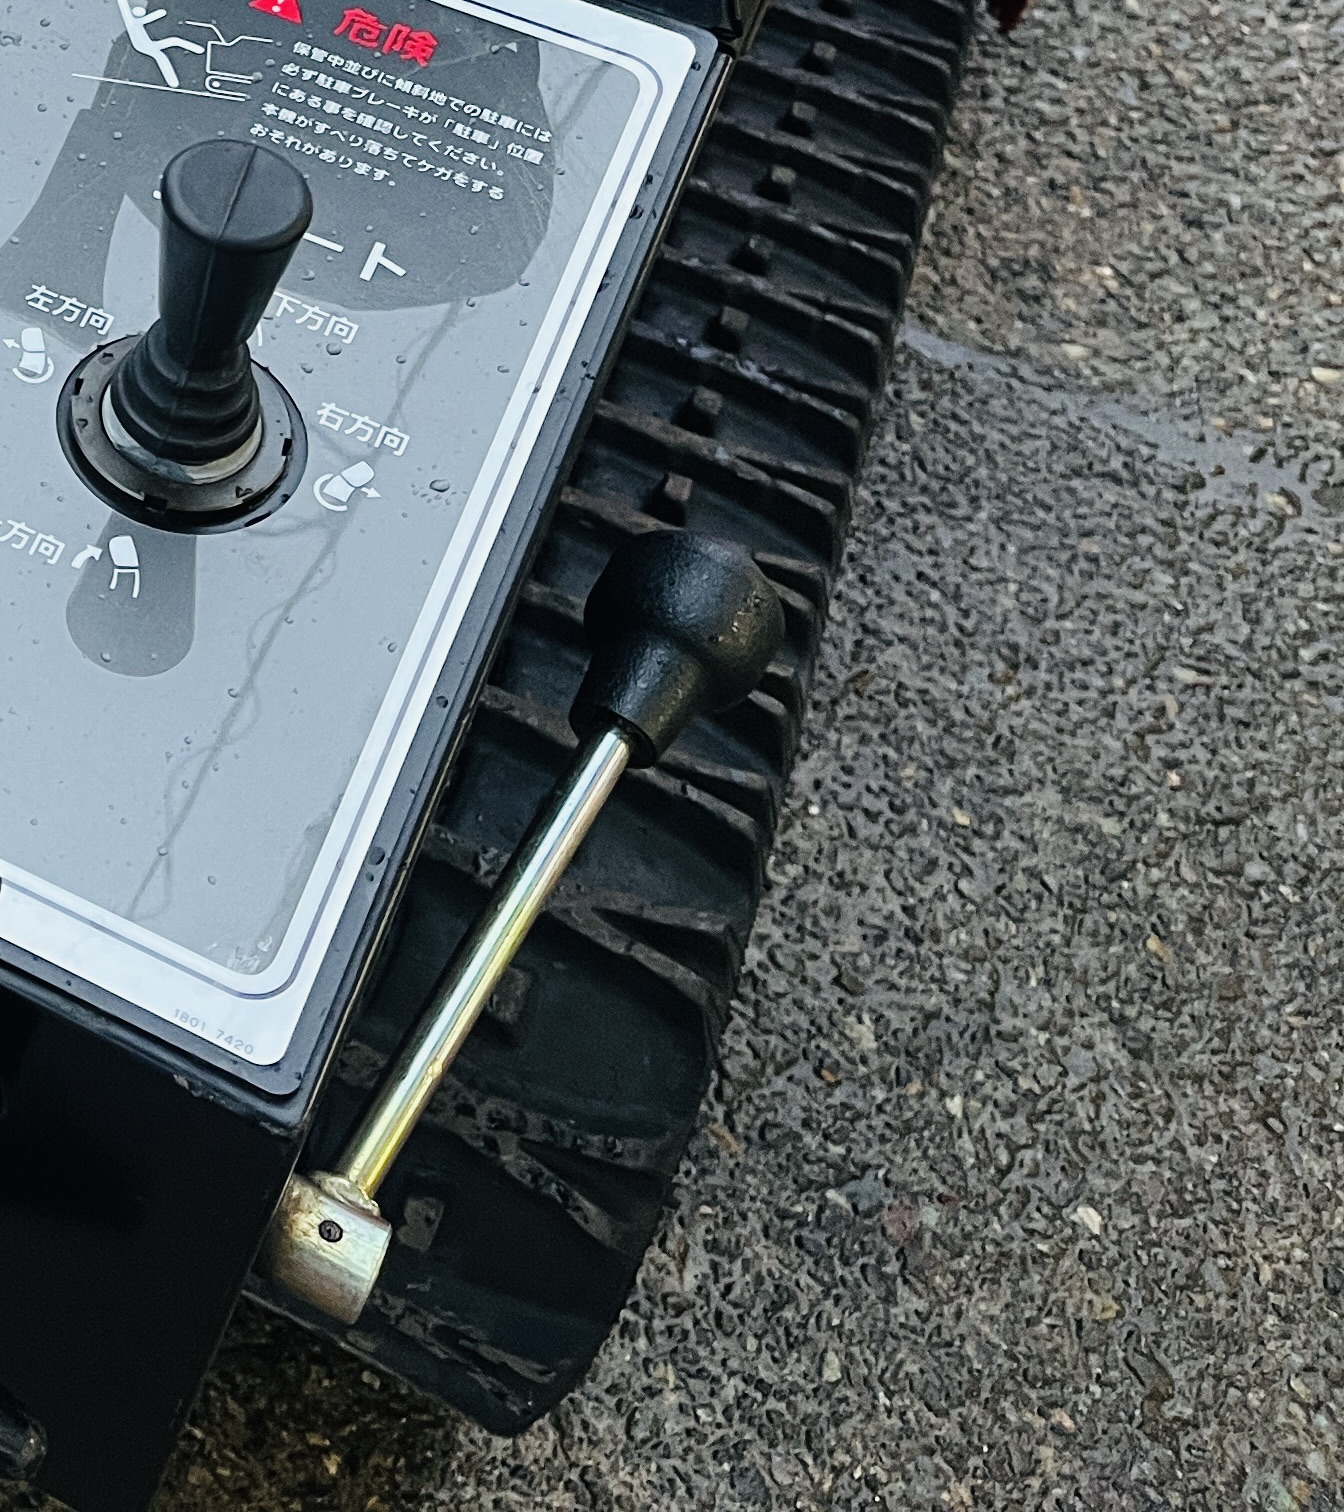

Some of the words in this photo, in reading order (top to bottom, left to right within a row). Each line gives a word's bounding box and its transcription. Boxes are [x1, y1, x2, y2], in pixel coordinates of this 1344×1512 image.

[333, 7, 440, 68] 危険
[24, 284, 115, 336] 左方向
[273, 291, 359, 344] 下方向
[316, 402, 410, 457] 右方向
[174, 1008, 206, 1031] 1801
[216, 1029, 254, 1055] 7420
